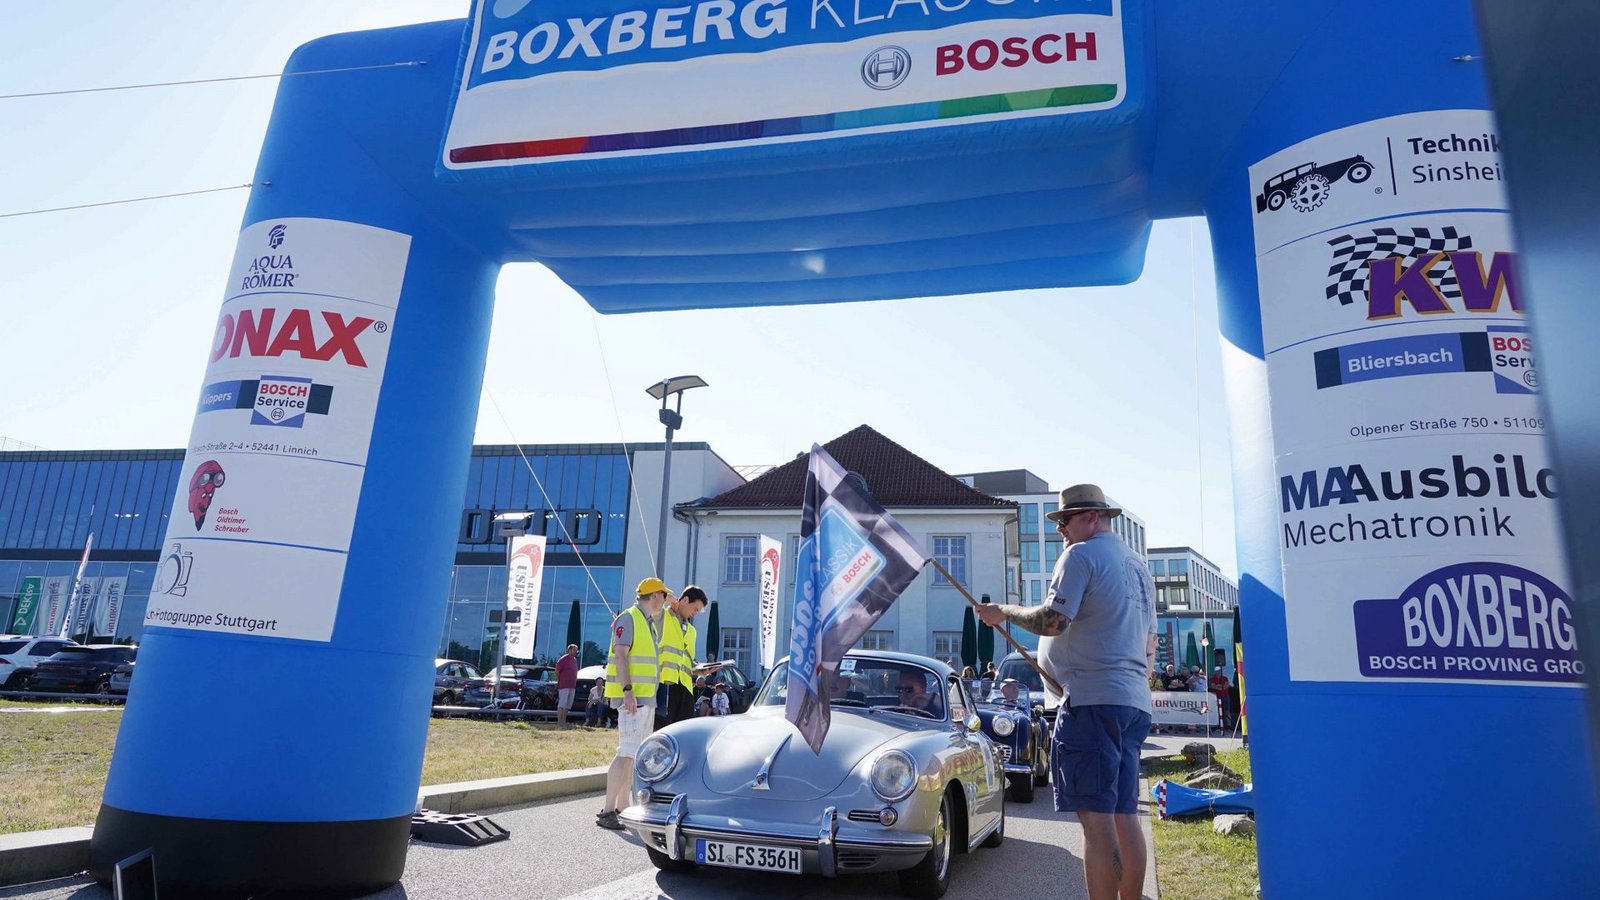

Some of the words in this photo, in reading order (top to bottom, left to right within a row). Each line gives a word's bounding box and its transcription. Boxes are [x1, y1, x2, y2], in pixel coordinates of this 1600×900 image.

[481, 0, 788, 74] BOXBERG
[936, 32, 1097, 76] BOSCH
[1407, 133, 1503, 155] Technik
[1412, 161, 1501, 183] Sinshei
[249, 254, 293, 273] AQUA
[242, 271, 295, 290] RÖMER
[1366, 250, 1528, 320] KW
[1347, 347, 1453, 373] Bliersbach
[1496, 354, 1536, 368] Serv
[260, 383, 307, 397] BOSCH
[257, 396, 305, 409] Service
[1350, 422, 1404, 438] Olpener
[1410, 418, 1457, 431] Straße
[1462, 417, 1489, 428] 750
[1504, 417, 1545, 431] 51109
[252, 443, 279, 452] 52441
[283, 445, 318, 456] Linnich
[216, 516, 247, 525] Oldtimer
[218, 507, 239, 516] Bosch
[214, 525, 250, 533] Schrauber
[1284, 507, 1515, 548] Mechatronik
[842, 551, 872, 585] BOSCH
[514, 565, 527, 603] USED
[523, 582, 534, 628] RAMSTEIN
[1402, 573, 1578, 652] BOXBERG
[215, 612, 277, 631] Stuttgart
[1369, 655, 1437, 671] BOSCH
[1443, 656, 1538, 673] PROVING
[1543, 659, 1585, 675] GRO
[707, 843, 725, 863] SI
[735, 846, 755, 866] FS
[758, 849, 799, 870] 356H
